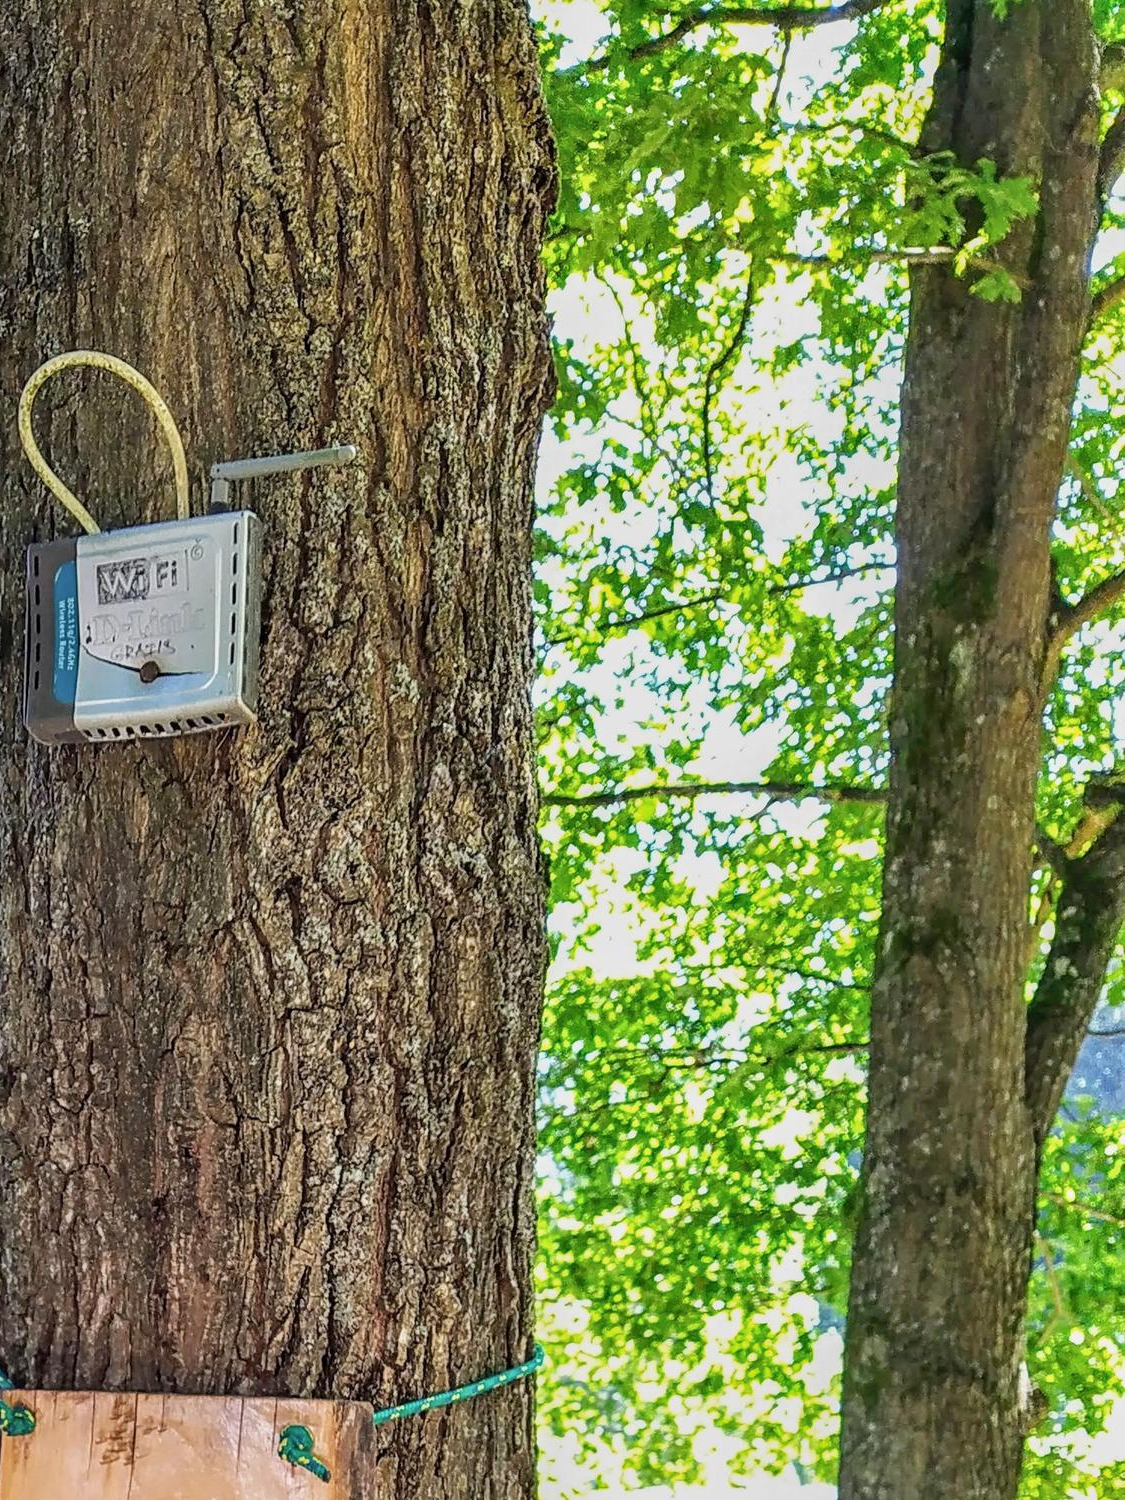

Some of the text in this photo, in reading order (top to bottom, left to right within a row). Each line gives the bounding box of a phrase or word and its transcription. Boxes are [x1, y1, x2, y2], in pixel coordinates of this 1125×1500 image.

[58, 600, 67, 670] Wireless Router
[110, 639, 176, 661] GRATIS
